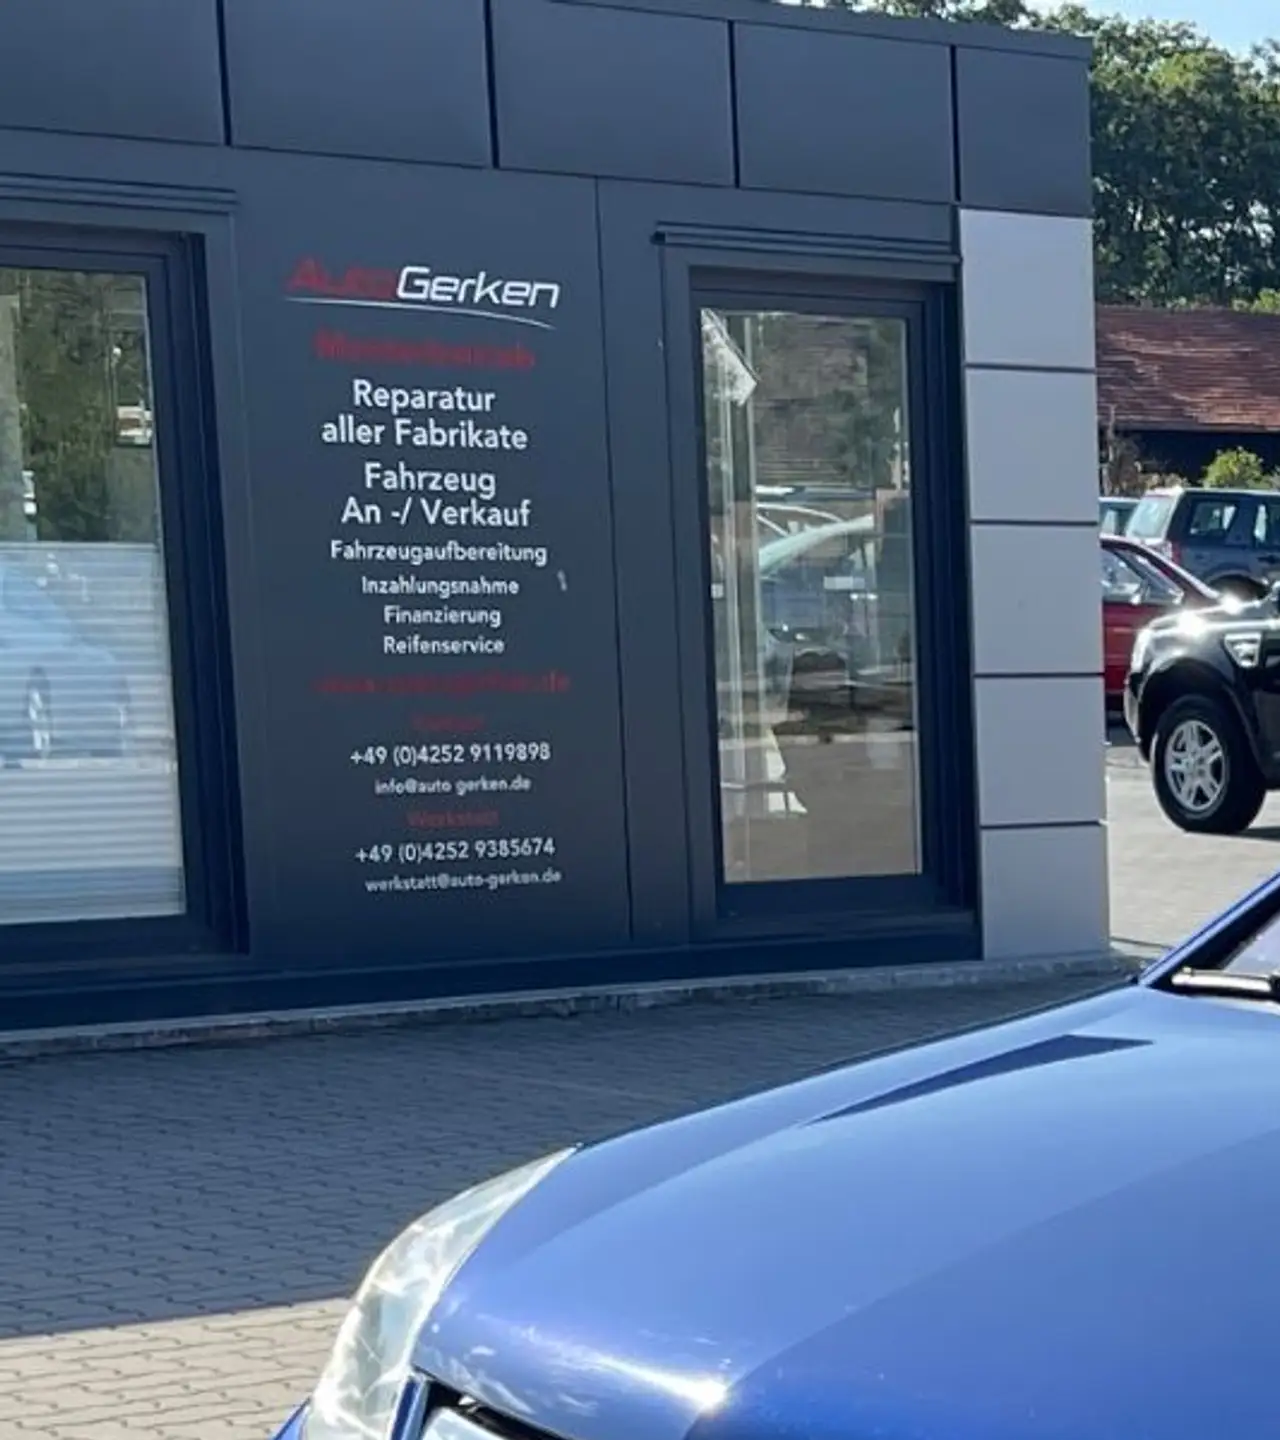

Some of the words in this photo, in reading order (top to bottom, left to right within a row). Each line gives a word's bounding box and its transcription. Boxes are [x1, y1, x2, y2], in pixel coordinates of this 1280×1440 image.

[353, 379, 496, 413] Reparatur
[321, 414, 385, 446] aller
[394, 418, 528, 450] Fabrikate
[364, 462, 497, 500] Fahrzeug
[341, 497, 382, 525] An
[420, 499, 532, 527] Verkauf
[330, 540, 548, 567] Fahrzeugaufbereitung
[361, 576, 520, 599] Inzahlungsnahme
[383, 605, 502, 628] Finanzierung
[383, 636, 505, 655] Reifenservice
[350, 746, 388, 765] +49
[393, 744, 464, 767] (0)4252
[470, 741, 551, 763] 9119898
[355, 844, 393, 863] +49
[398, 840, 469, 864] (0)4252
